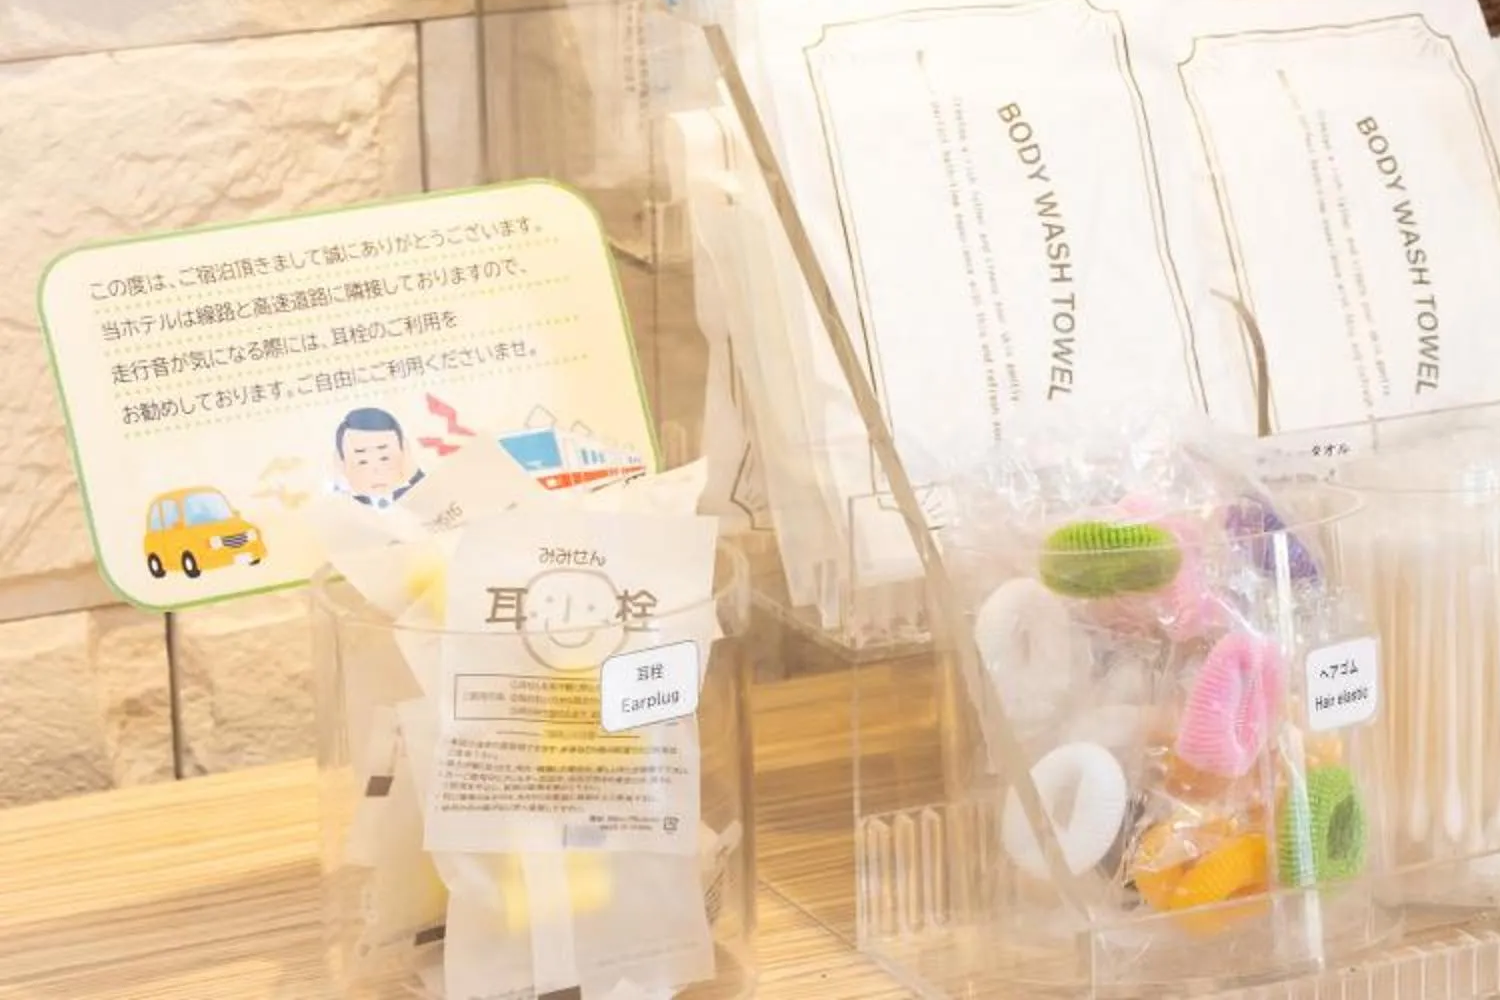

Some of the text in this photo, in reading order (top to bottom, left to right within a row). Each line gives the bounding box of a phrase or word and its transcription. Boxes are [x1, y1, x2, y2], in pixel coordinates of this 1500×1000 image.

[90, 216, 542, 301] この度は、ご宿泊頂きまして誠にありがとうございます。
[997, 102, 1076, 401] BODY WASH TOWEL
[1356, 116, 1440, 395] BODY WASH TOWEL
[101, 258, 528, 341] 当ホテルは線路と高速道路に隣接しておりますので、
[111, 310, 458, 384] 走行音が気になる際には、耳栓のご利用を
[122, 340, 537, 425] お勧めしております。ご自由にご利用くださいませ。
[539, 547, 607, 567] みみせん
[621, 690, 680, 713] Earplug
[636, 663, 664, 681] 耳栓
[1315, 695, 1335, 713] Hair
[1319, 659, 1359, 679] ヘアゴム
